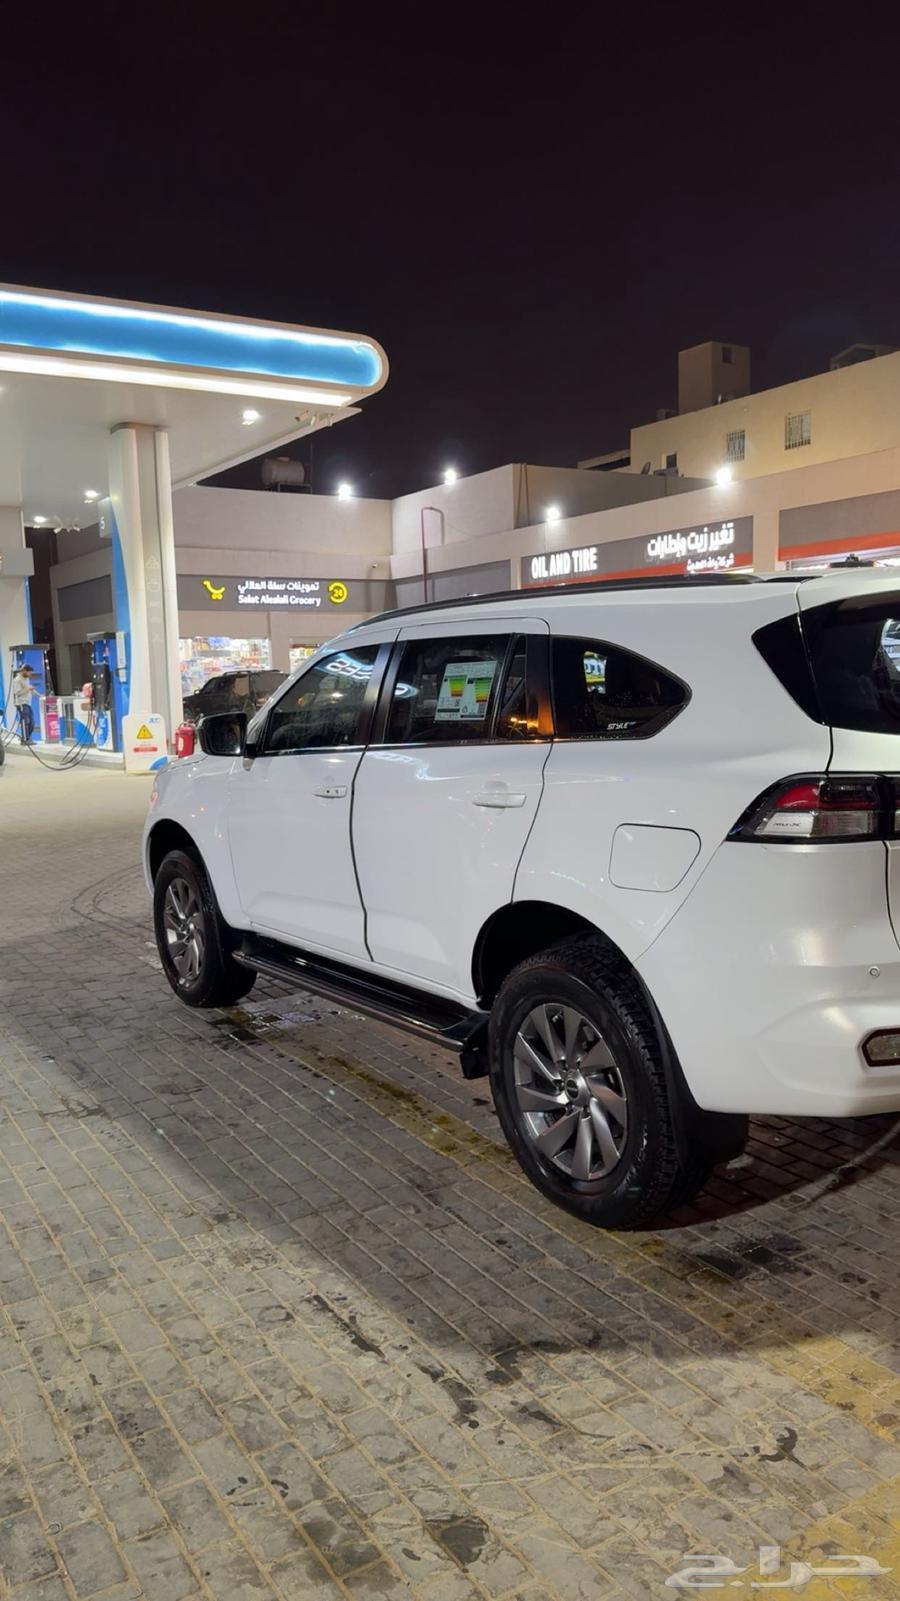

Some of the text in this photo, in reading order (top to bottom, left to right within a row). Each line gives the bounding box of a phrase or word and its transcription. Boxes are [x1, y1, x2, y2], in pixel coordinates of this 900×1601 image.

[687, 527, 708, 553] زيت
[531, 547, 598, 579] OIL AND TIRE
[268, 581, 286, 591] سلة
[287, 581, 319, 593] تموينات
[333, 588, 344, 598] 24
[238, 595, 260, 604] Salat
[289, 595, 321, 607] Grocery
[606, 721, 629, 731] STYLE
